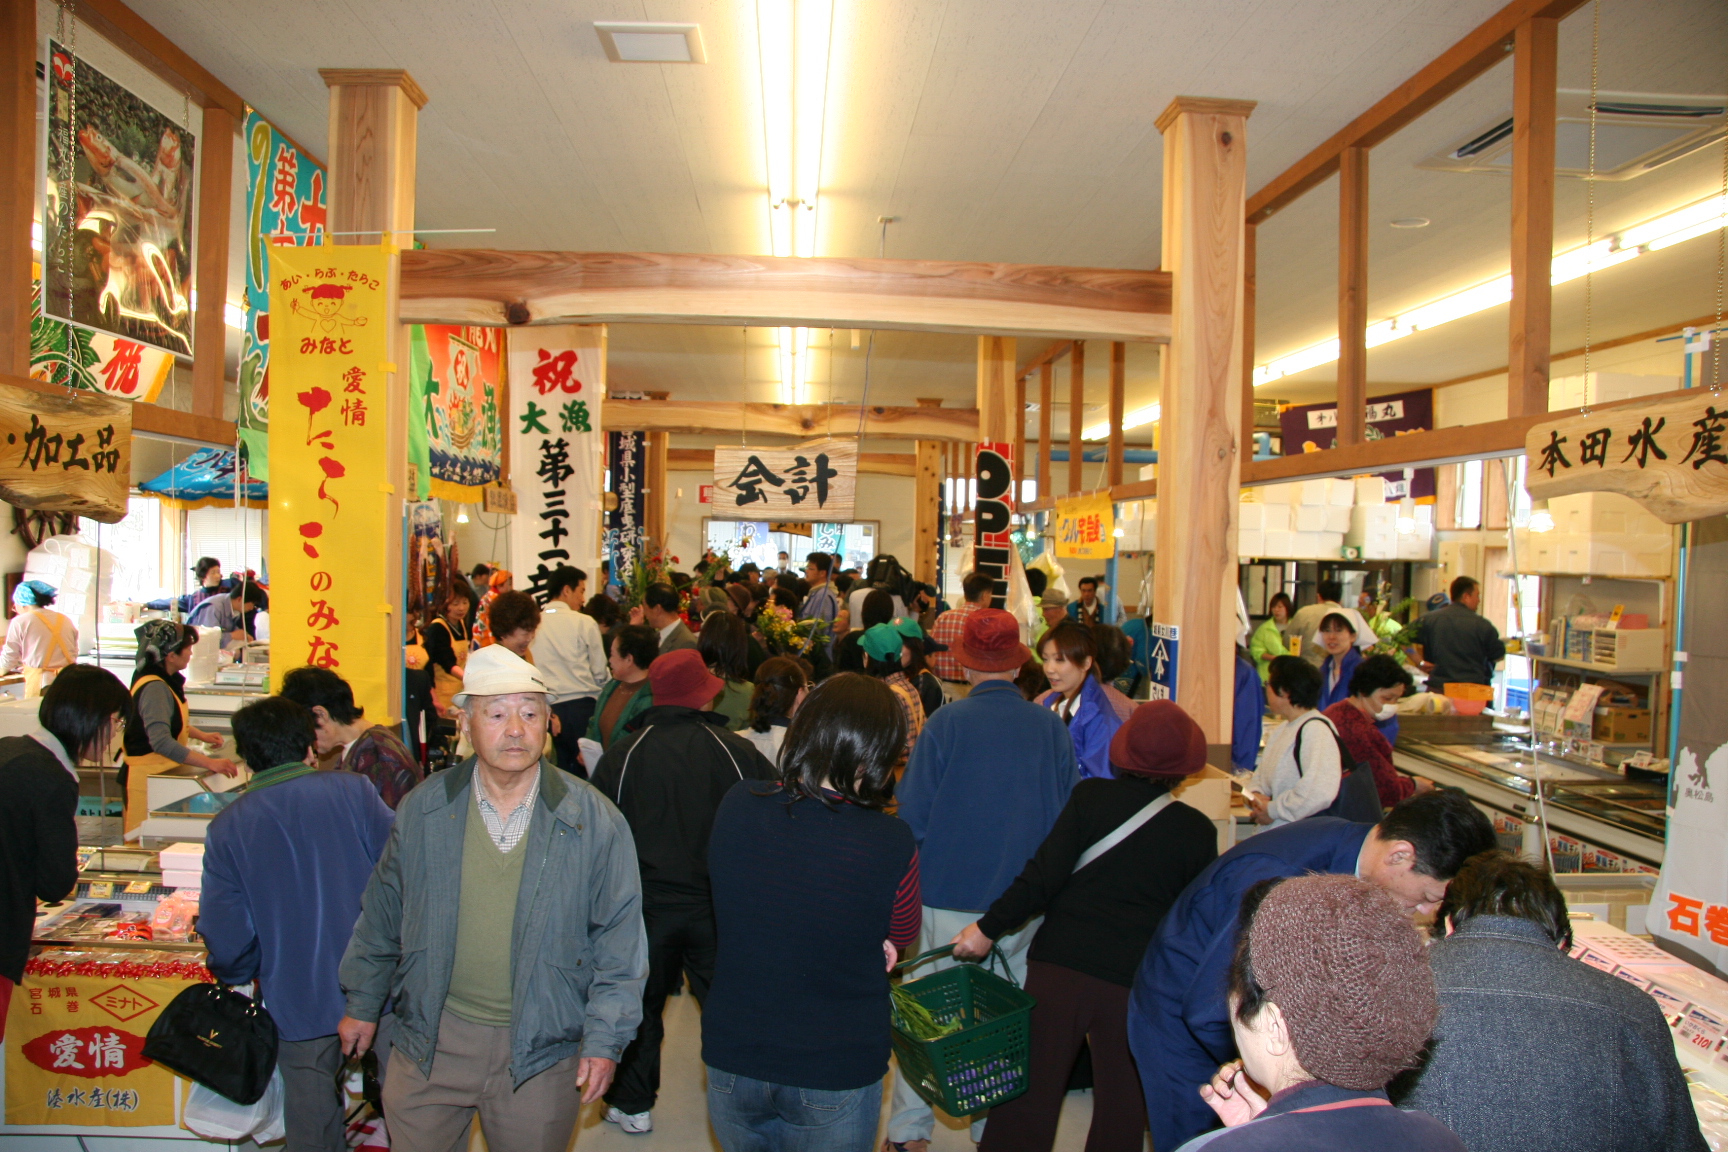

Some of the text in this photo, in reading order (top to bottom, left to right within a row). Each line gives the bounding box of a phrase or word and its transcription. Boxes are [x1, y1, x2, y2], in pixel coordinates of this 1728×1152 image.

[280, 268, 380, 291] あい・らぶ・たらこ
[300, 337, 354, 354] みなと
[532, 348, 582, 395] 祝
[340, 366, 368, 427] 愛情
[1537, 406, 1728, 478] 本田水産
[727, 453, 838, 509] 会計
[1685, 788, 1714, 802] 奥松島
[1668, 893, 1728, 946] 石巻
[29, 987, 79, 999] 宮城県
[106, 996, 143, 1010] ミナト
[31, 1001, 79, 1015] 石巻
[50, 1033, 127, 1069] 愛情
[47, 1087, 139, 1111] 湊水産(株)
